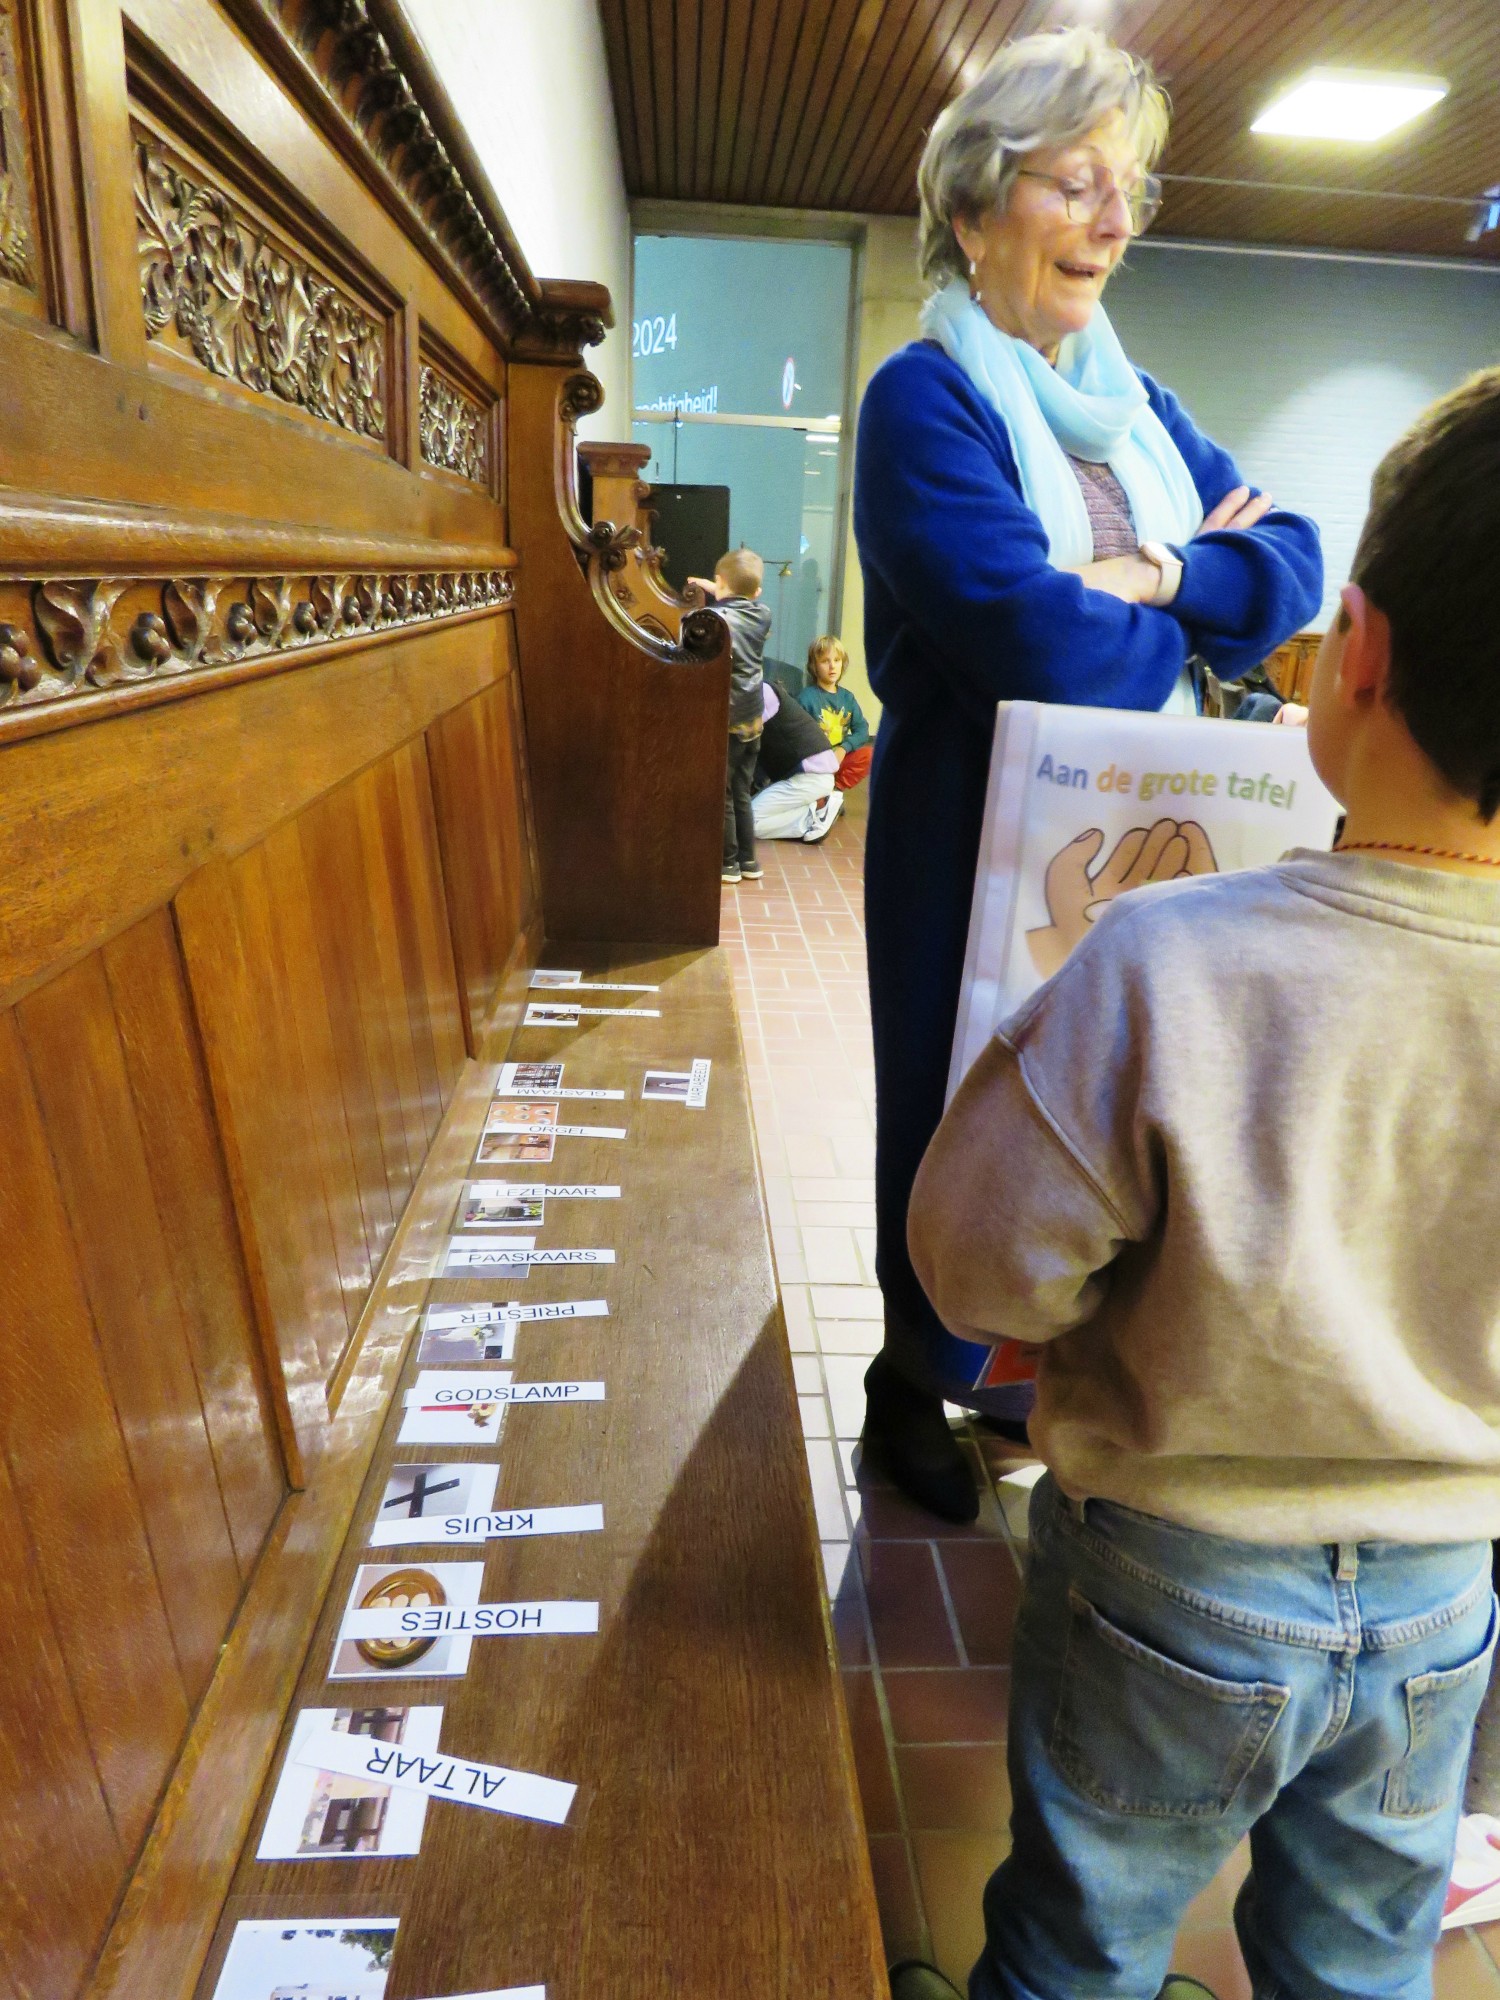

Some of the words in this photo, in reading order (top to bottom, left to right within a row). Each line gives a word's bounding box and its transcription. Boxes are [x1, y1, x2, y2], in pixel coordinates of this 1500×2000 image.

[632, 313, 677, 358] 2024
[1036, 754, 1089, 790] Aan
[1096, 764, 1132, 793] de
[1138, 769, 1217, 801] grote
[1227, 772, 1297, 810] tafel
[690, 1063, 707, 1101] MARIABEELD
[517, 1088, 606, 1097] GLASRAAM
[529, 1125, 587, 1135] ORGEL
[496, 1187, 597, 1197] LEZENAAR
[468, 1251, 597, 1263] PAASKAARS
[461, 1305, 575, 1324] PRIESTER
[435, 1385, 580, 1402] GODSLAMP
[445, 1513, 534, 1535] KRUIS
[401, 1608, 541, 1632] HOSTIES
[366, 1747, 507, 1799] ALTAAR
